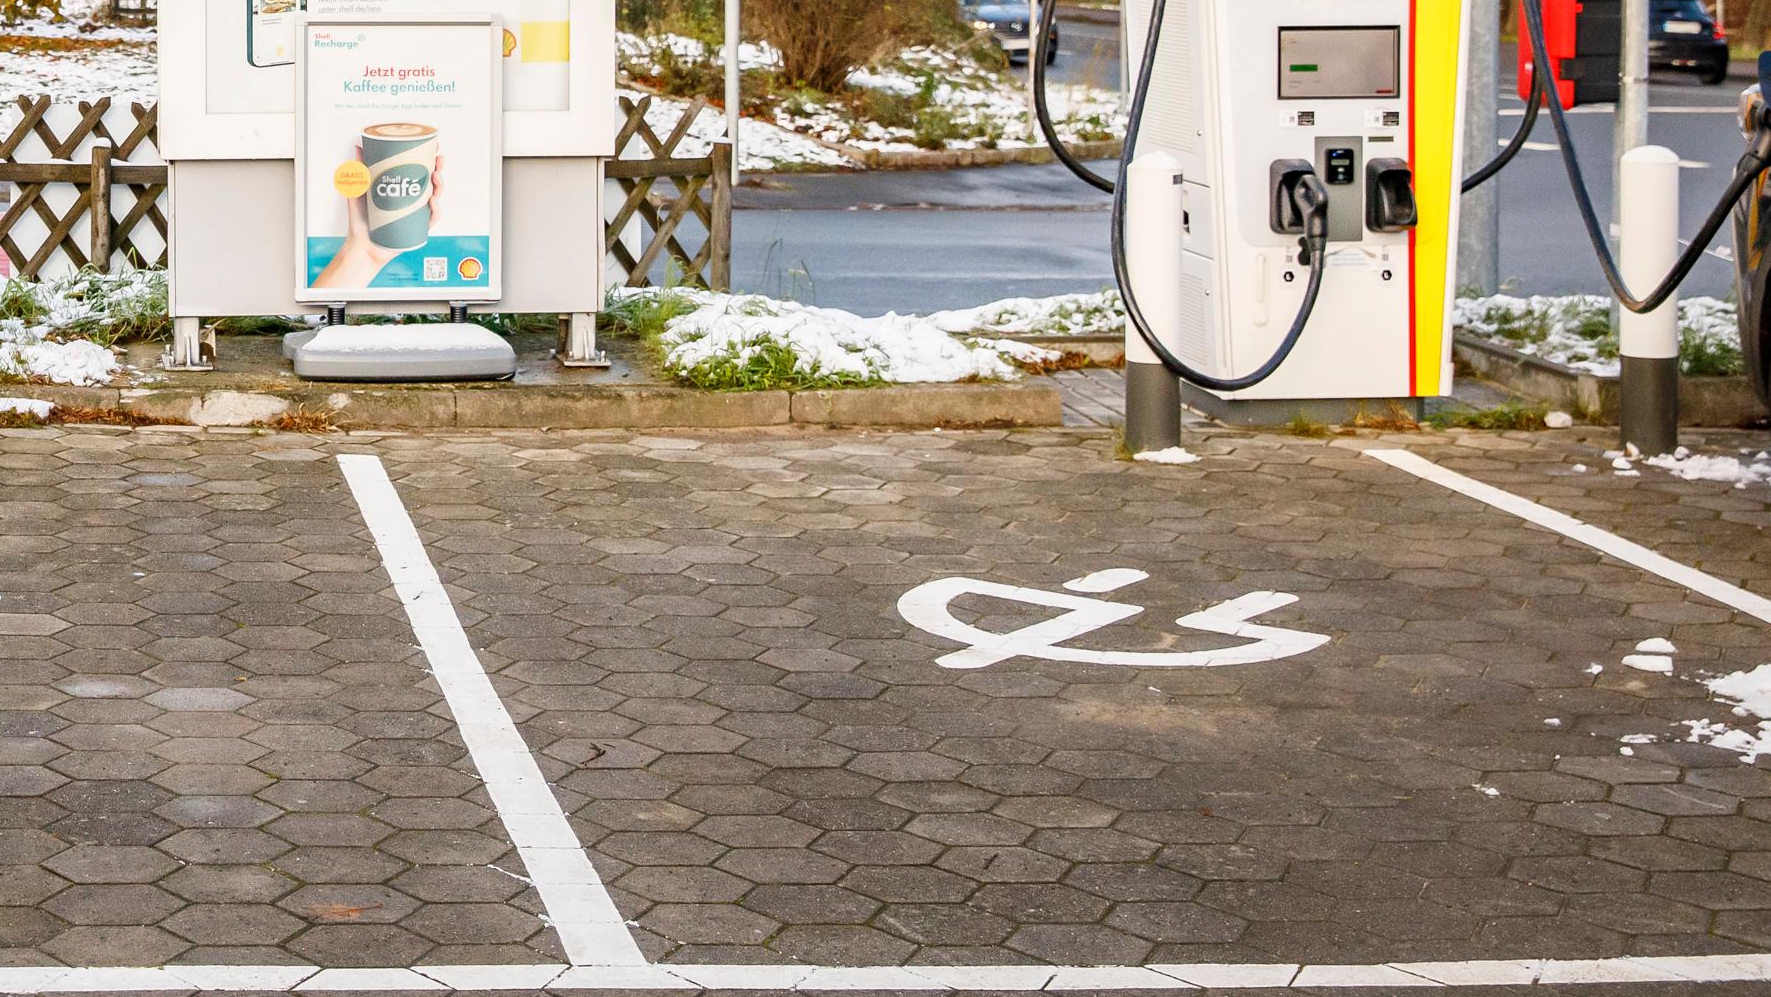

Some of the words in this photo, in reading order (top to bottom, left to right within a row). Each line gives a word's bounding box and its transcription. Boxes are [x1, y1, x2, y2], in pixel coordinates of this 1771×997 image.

[318, 5, 337, 13] unter
[314, 39, 359, 50] Recharge
[363, 66, 395, 77] Jetzt
[398, 65, 436, 80] gratis
[344, 80, 387, 93] Kaffee
[390, 80, 456, 96] genießen!
[382, 175, 401, 183] Shell
[376, 177, 421, 197] café
